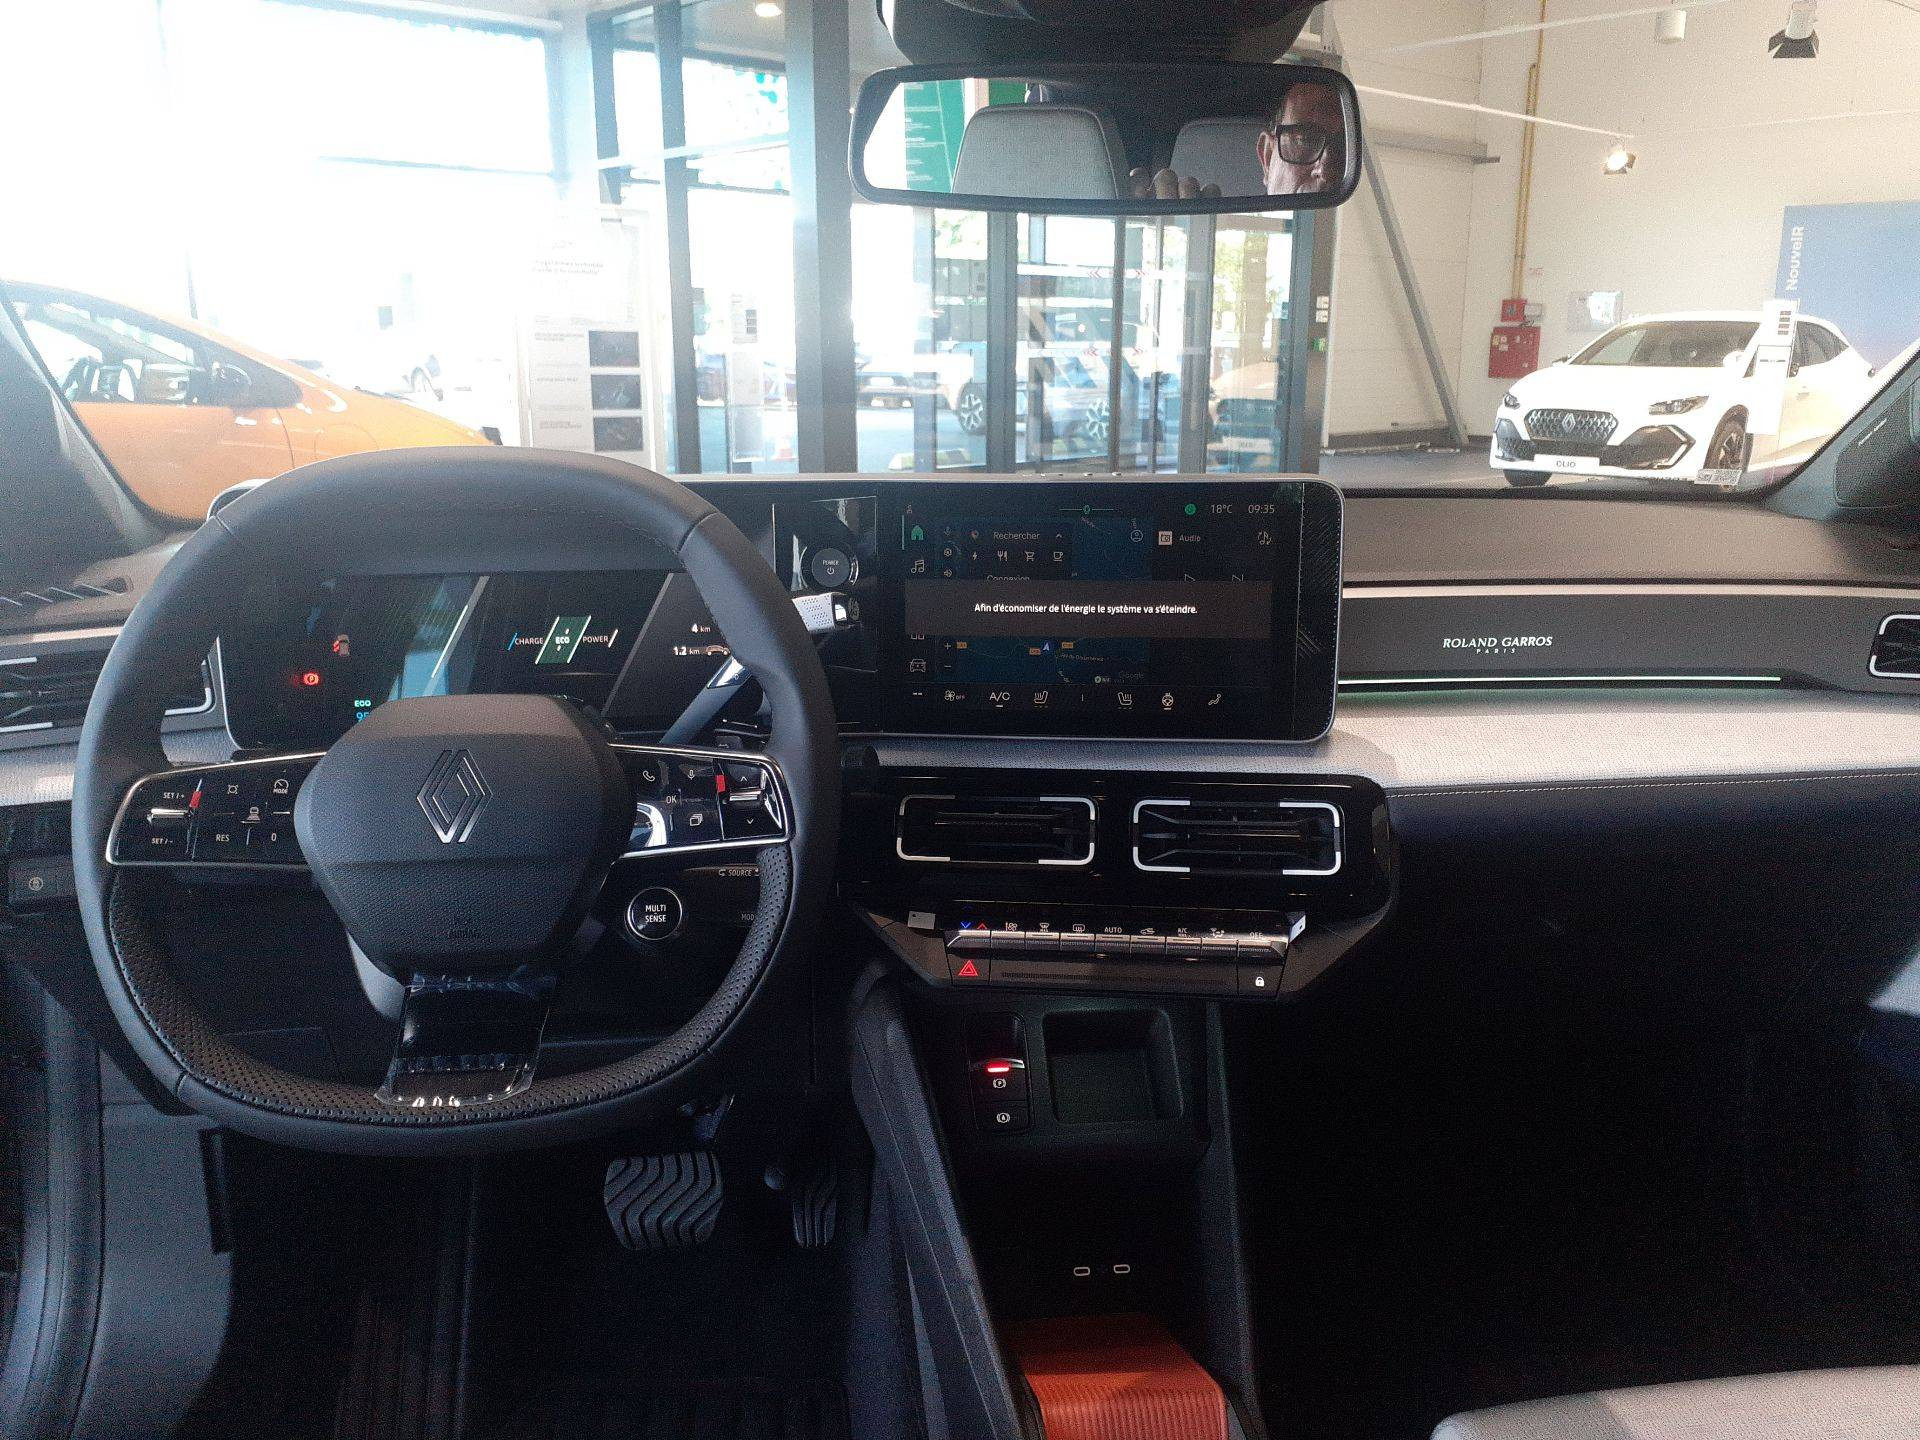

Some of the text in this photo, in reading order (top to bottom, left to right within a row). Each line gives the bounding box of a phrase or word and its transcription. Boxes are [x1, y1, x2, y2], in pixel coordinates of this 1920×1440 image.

[1210, 504, 1275, 514] 18°C 09:35
[993, 532, 1040, 541] Rechercher
[1179, 534, 1201, 543] Audio
[974, 603, 992, 612] Afin
[992, 603, 1047, 613] d'économiser
[1048, 604, 1059, 613] de
[1097, 604, 1106, 613] le
[1107, 604, 1142, 615] système
[691, 624, 698, 633] 4
[514, 637, 544, 646] CHARGE
[555, 636, 570, 645] ECO
[582, 635, 609, 644] POWER
[1443, 636, 1553, 648] ROLAND GARROS
[673, 646, 688, 656] 1.2
[989, 692, 1011, 702] A/C
[354, 699, 371, 708] ECO
[666, 796, 677, 804] OK
[216, 833, 230, 842] RES
[728, 869, 752, 877] SOURCE
[645, 905, 667, 913] MULTI
[645, 914, 667, 923] SENSE
[1104, 926, 1122, 934] AUTO
